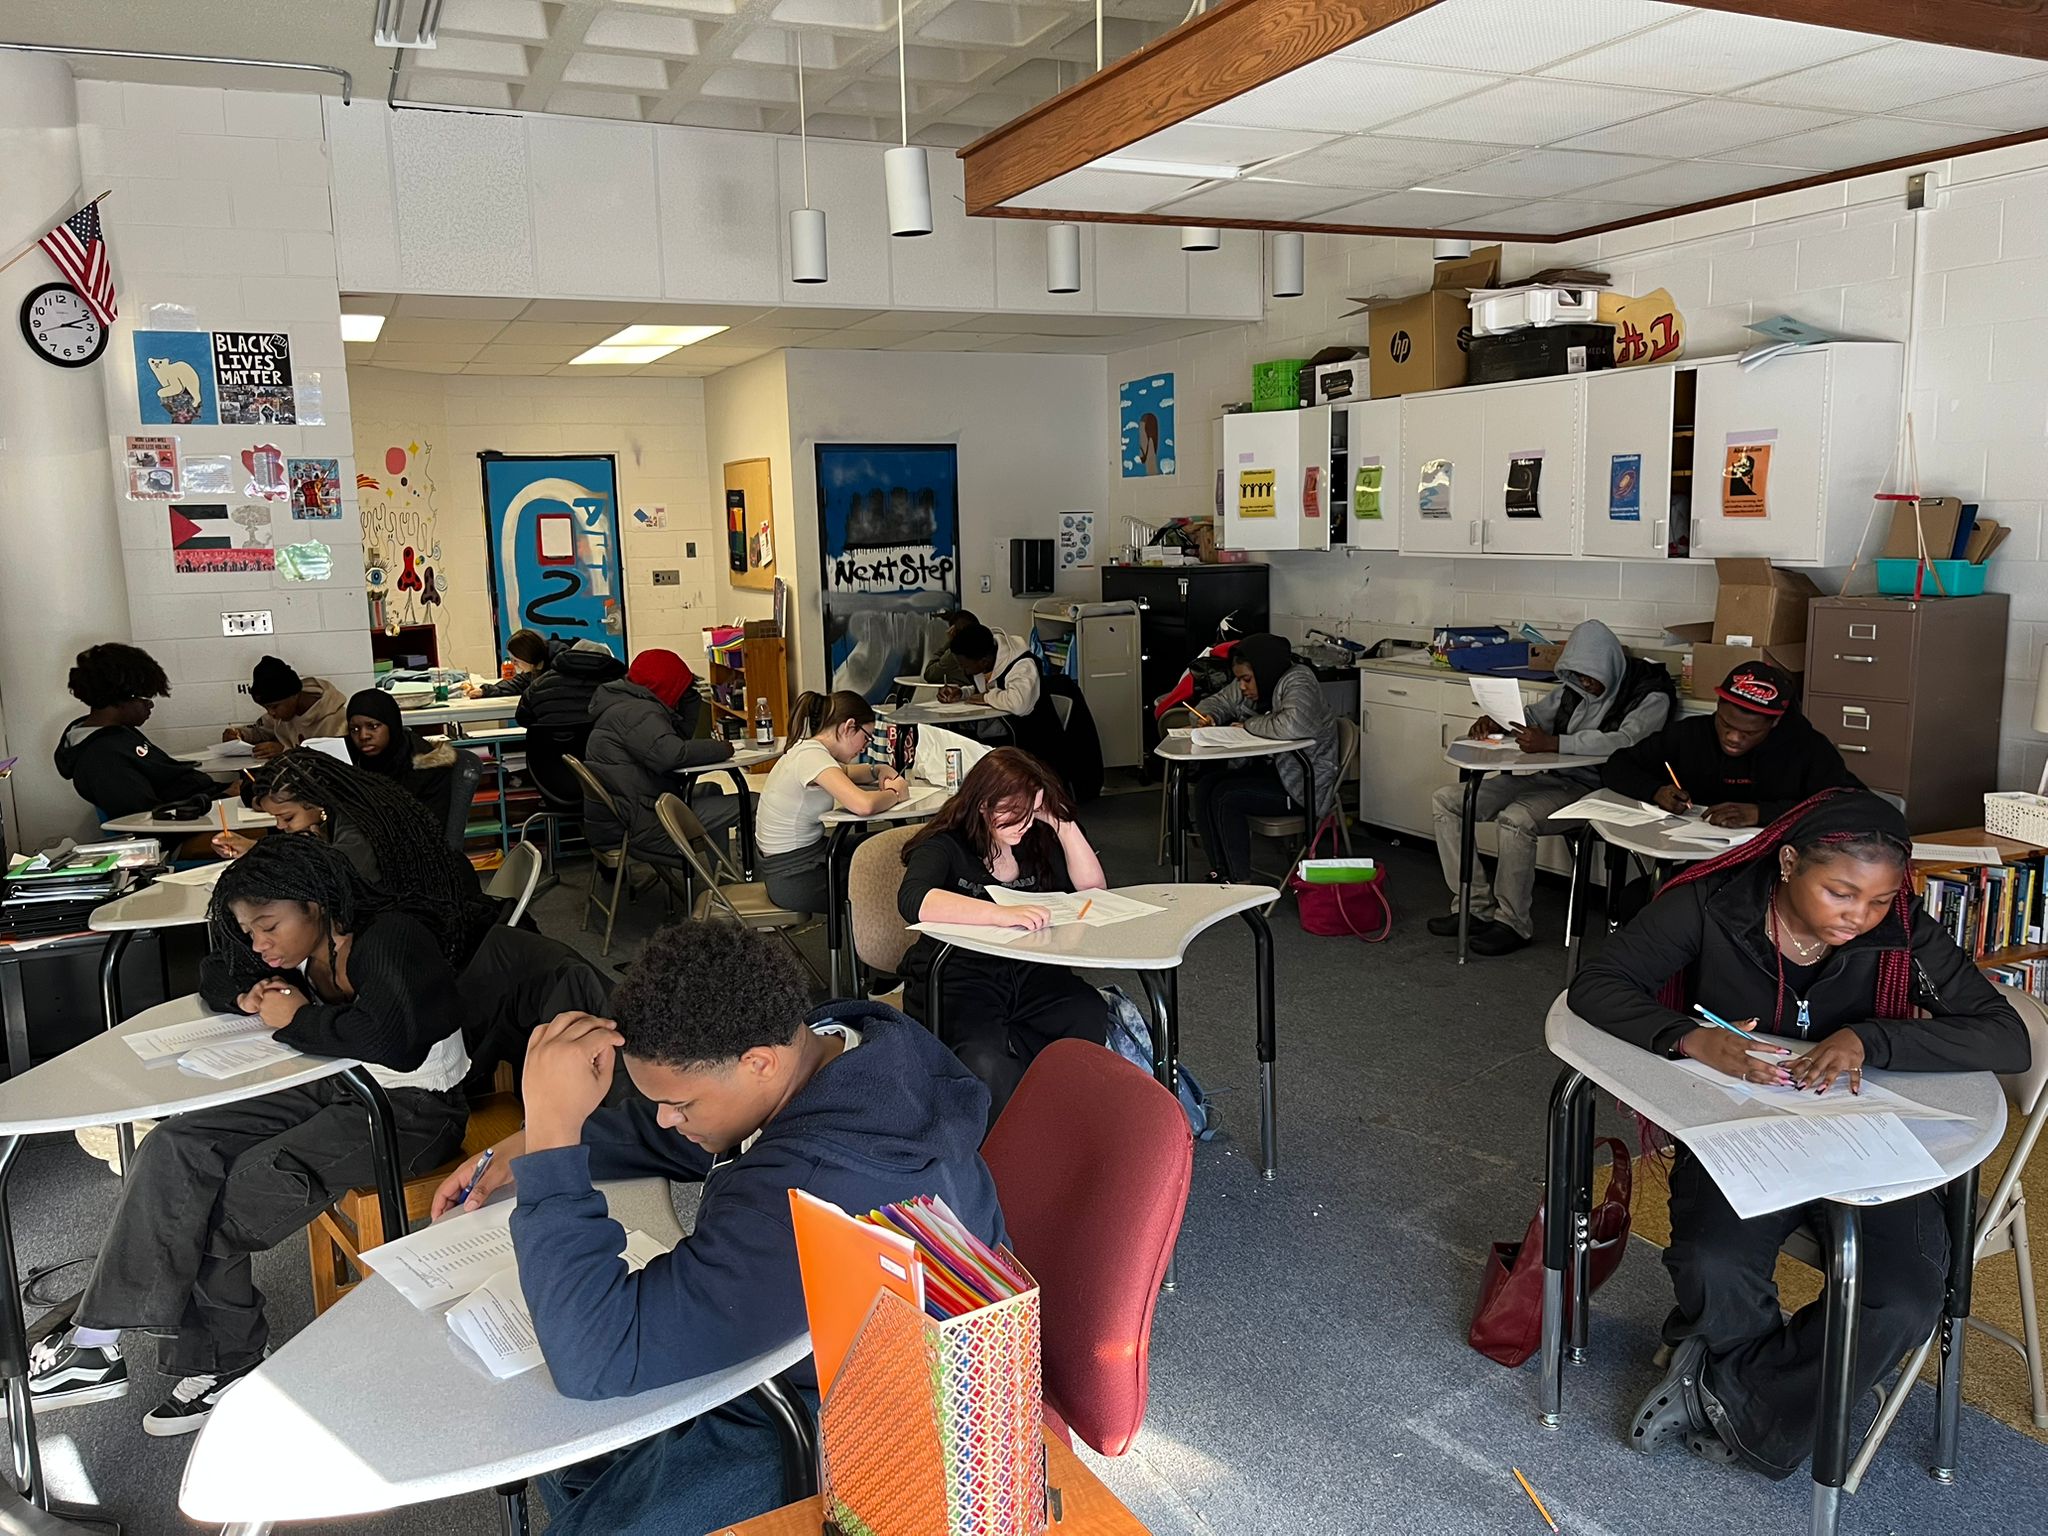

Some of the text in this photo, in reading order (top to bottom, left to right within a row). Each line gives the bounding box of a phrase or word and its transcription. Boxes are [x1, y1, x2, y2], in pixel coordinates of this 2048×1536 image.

[44, 298, 52, 306] 11
[55, 295, 67, 304] 12
[73, 300, 77, 308] 1
[35, 306, 45, 316] 10
[32, 319, 41, 328] 9
[86, 323, 95, 332] 3
[38, 333, 48, 342] 8
[49, 343, 57, 352] 7
[215, 333, 273, 353] BLACK
[1391, 331, 1409, 364] hp
[63, 348, 72, 357] 6
[76, 345, 85, 353] 5
[218, 354, 275, 371] LIVES
[220, 370, 283, 385] MATTER
[900, 554, 953, 591] Step
